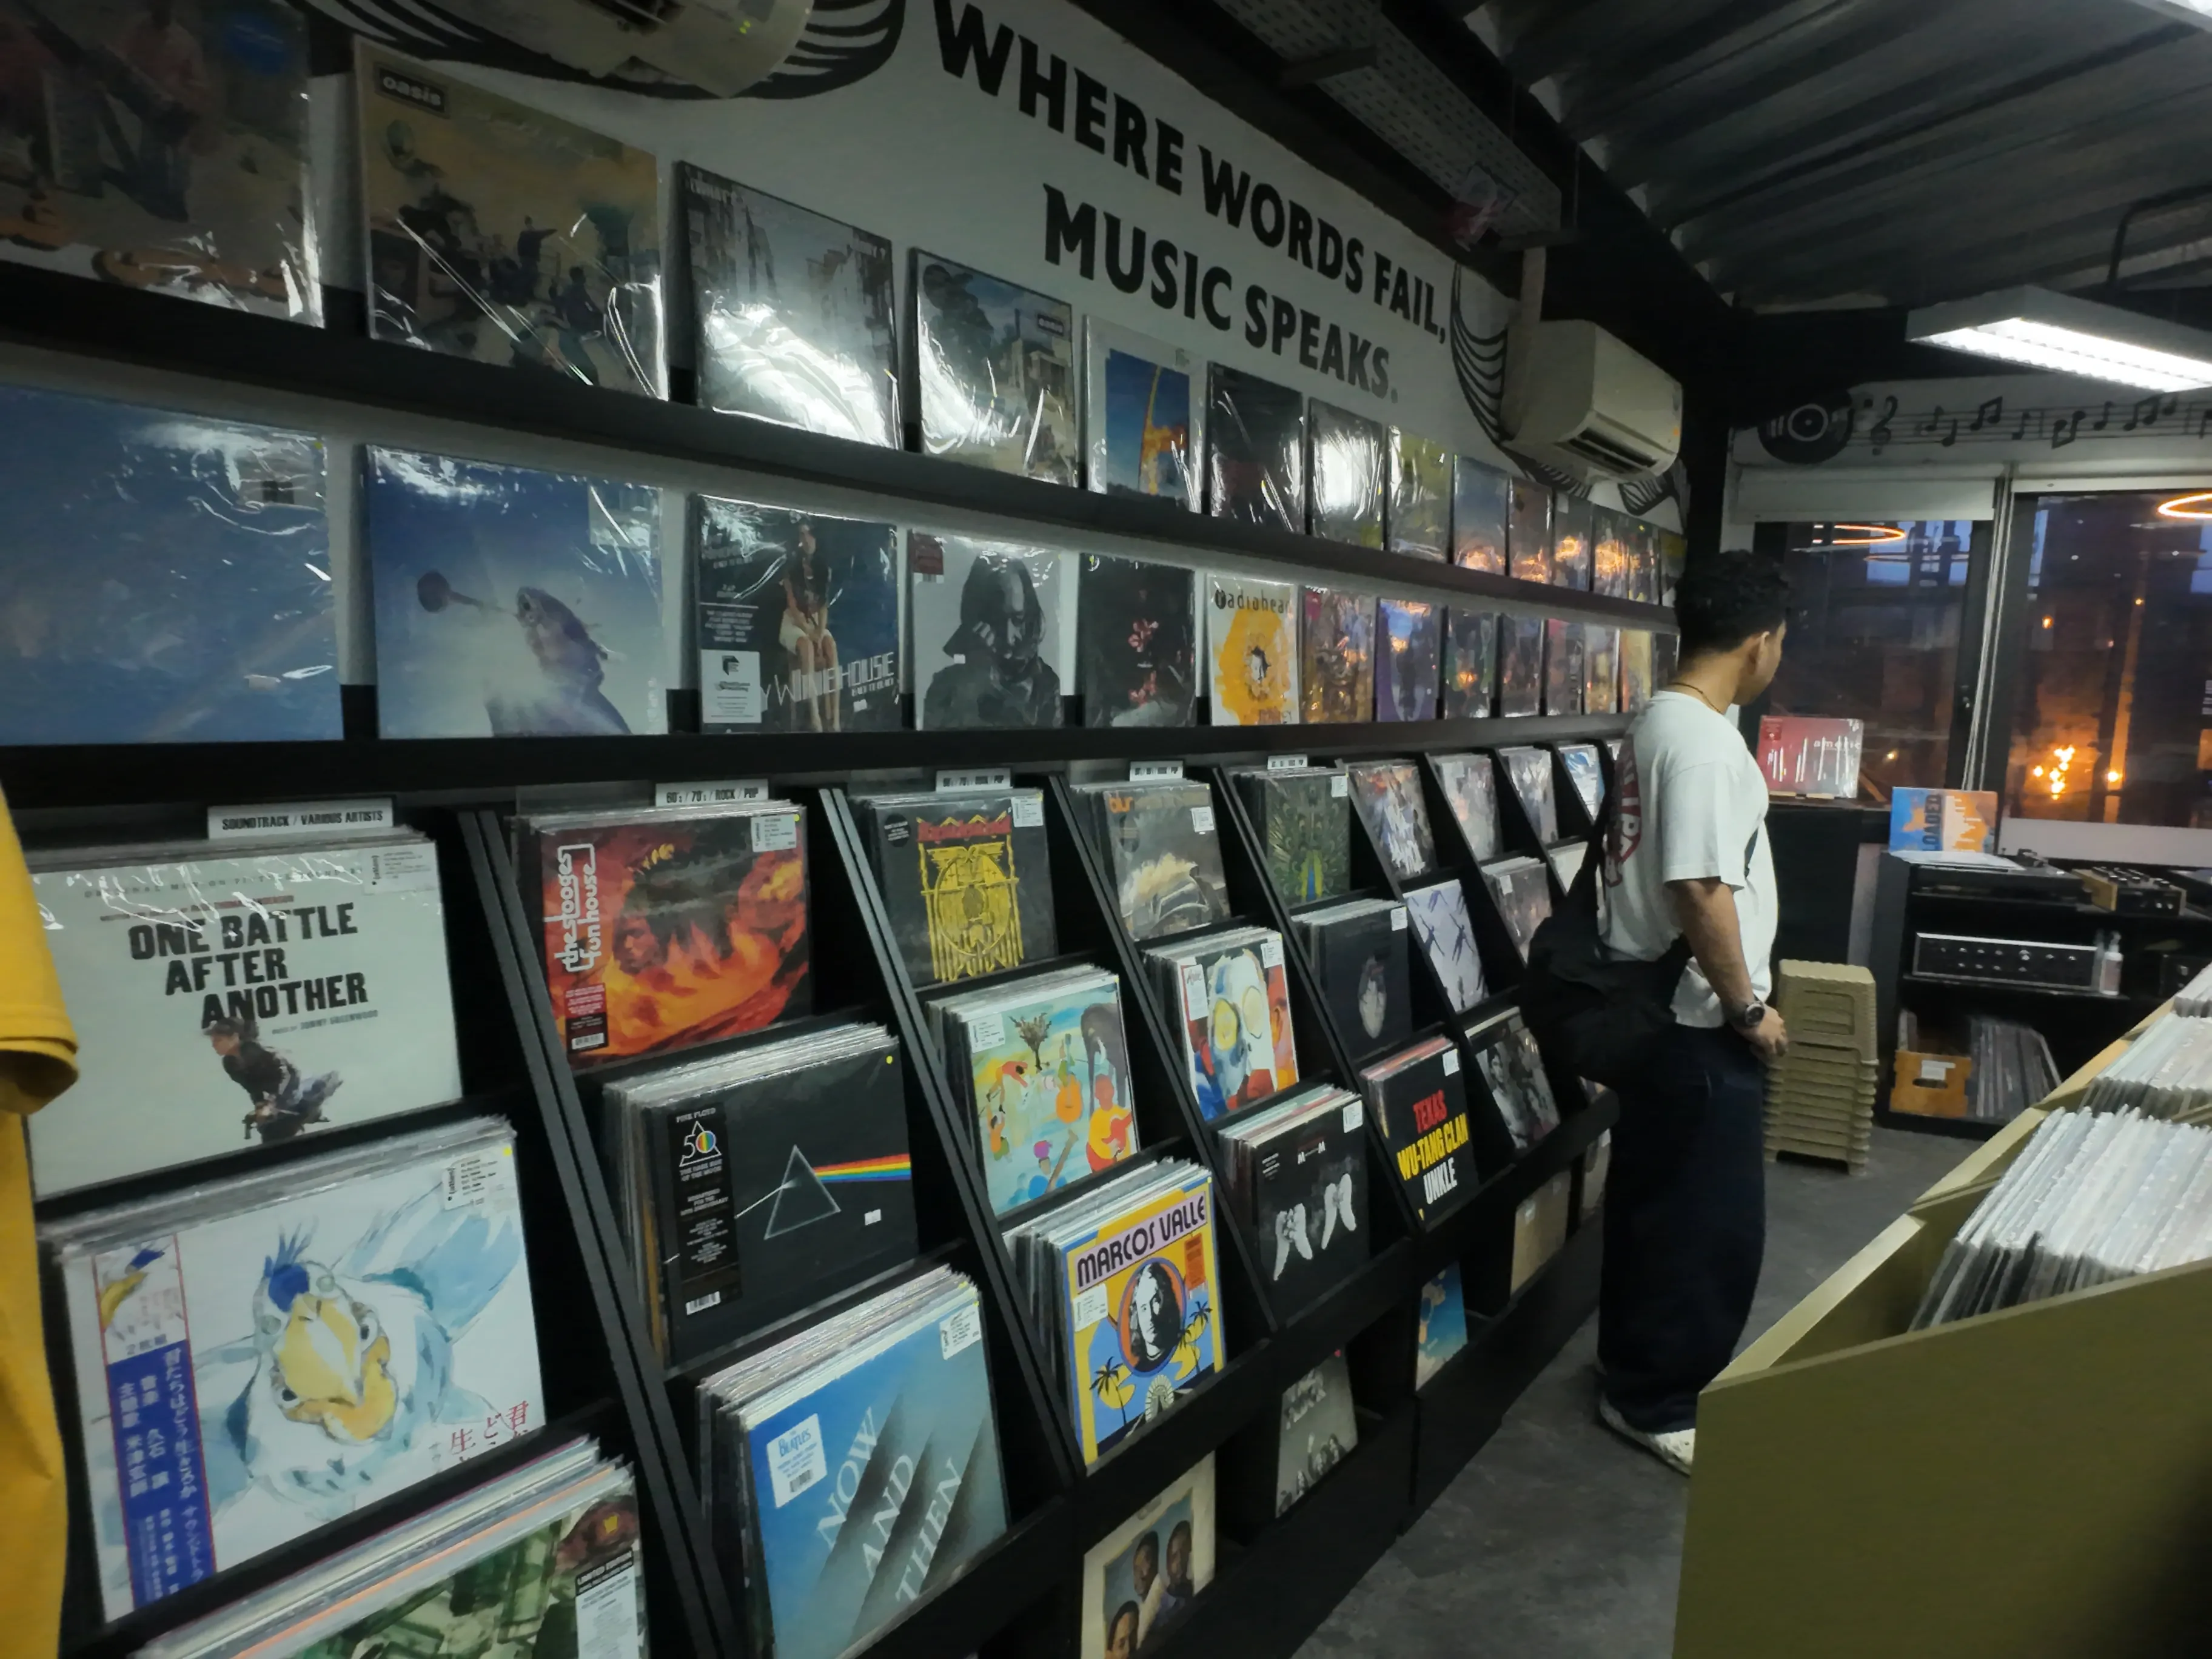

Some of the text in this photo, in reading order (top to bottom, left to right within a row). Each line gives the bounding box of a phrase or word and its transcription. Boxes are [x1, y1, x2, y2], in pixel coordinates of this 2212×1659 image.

[383, 76, 441, 105] oasis
[933, 0, 1446, 344] WHERE WORDS FAIL,
[1043, 183, 1398, 403] MUSIC SPEAKS.
[222, 815, 289, 830] SOUNDTRACK
[301, 813, 342, 825] VARIOUS
[346, 810, 383, 823] ARTISTS
[744, 788, 759, 799] POP
[128, 919, 210, 960] ONE
[220, 902, 358, 950] BATTLE
[166, 948, 289, 996] AFTER
[201, 972, 368, 1030] ANOTHER
[1413, 1089, 1447, 1134] TEXAS
[1397, 1112, 1469, 1181] WU-TANG CLAN
[1423, 1157, 1458, 1204] UNKLE
[1077, 1222, 1155, 1288] MARCOS
[1159, 1196, 1205, 1241] VALLE
[816, 1406, 877, 1550] NOW
[863, 1454, 913, 1580] AND
[895, 1457, 962, 1601] THEN
